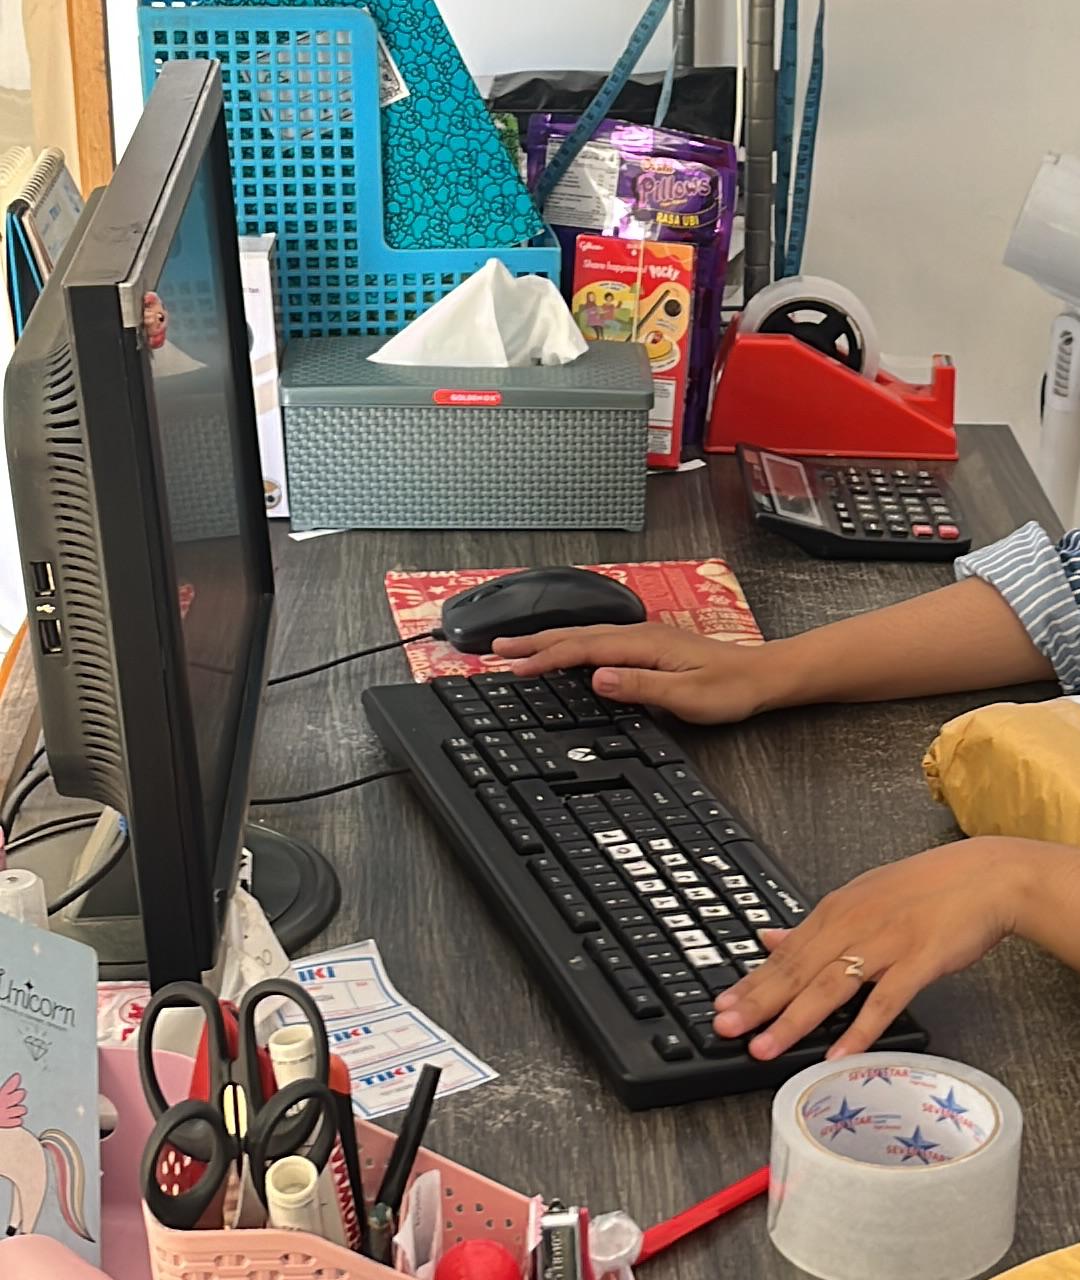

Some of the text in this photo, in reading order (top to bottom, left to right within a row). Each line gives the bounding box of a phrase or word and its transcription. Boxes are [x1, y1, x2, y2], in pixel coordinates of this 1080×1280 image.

[637, 172, 711, 208] Pillows
[656, 212, 681, 225] RASA
[298, 966, 336, 982] IKI
[333, 1026, 373, 1043] IKI
[359, 1064, 416, 1086] TIKI
[330, 1132, 361, 1250] SNOWMA
